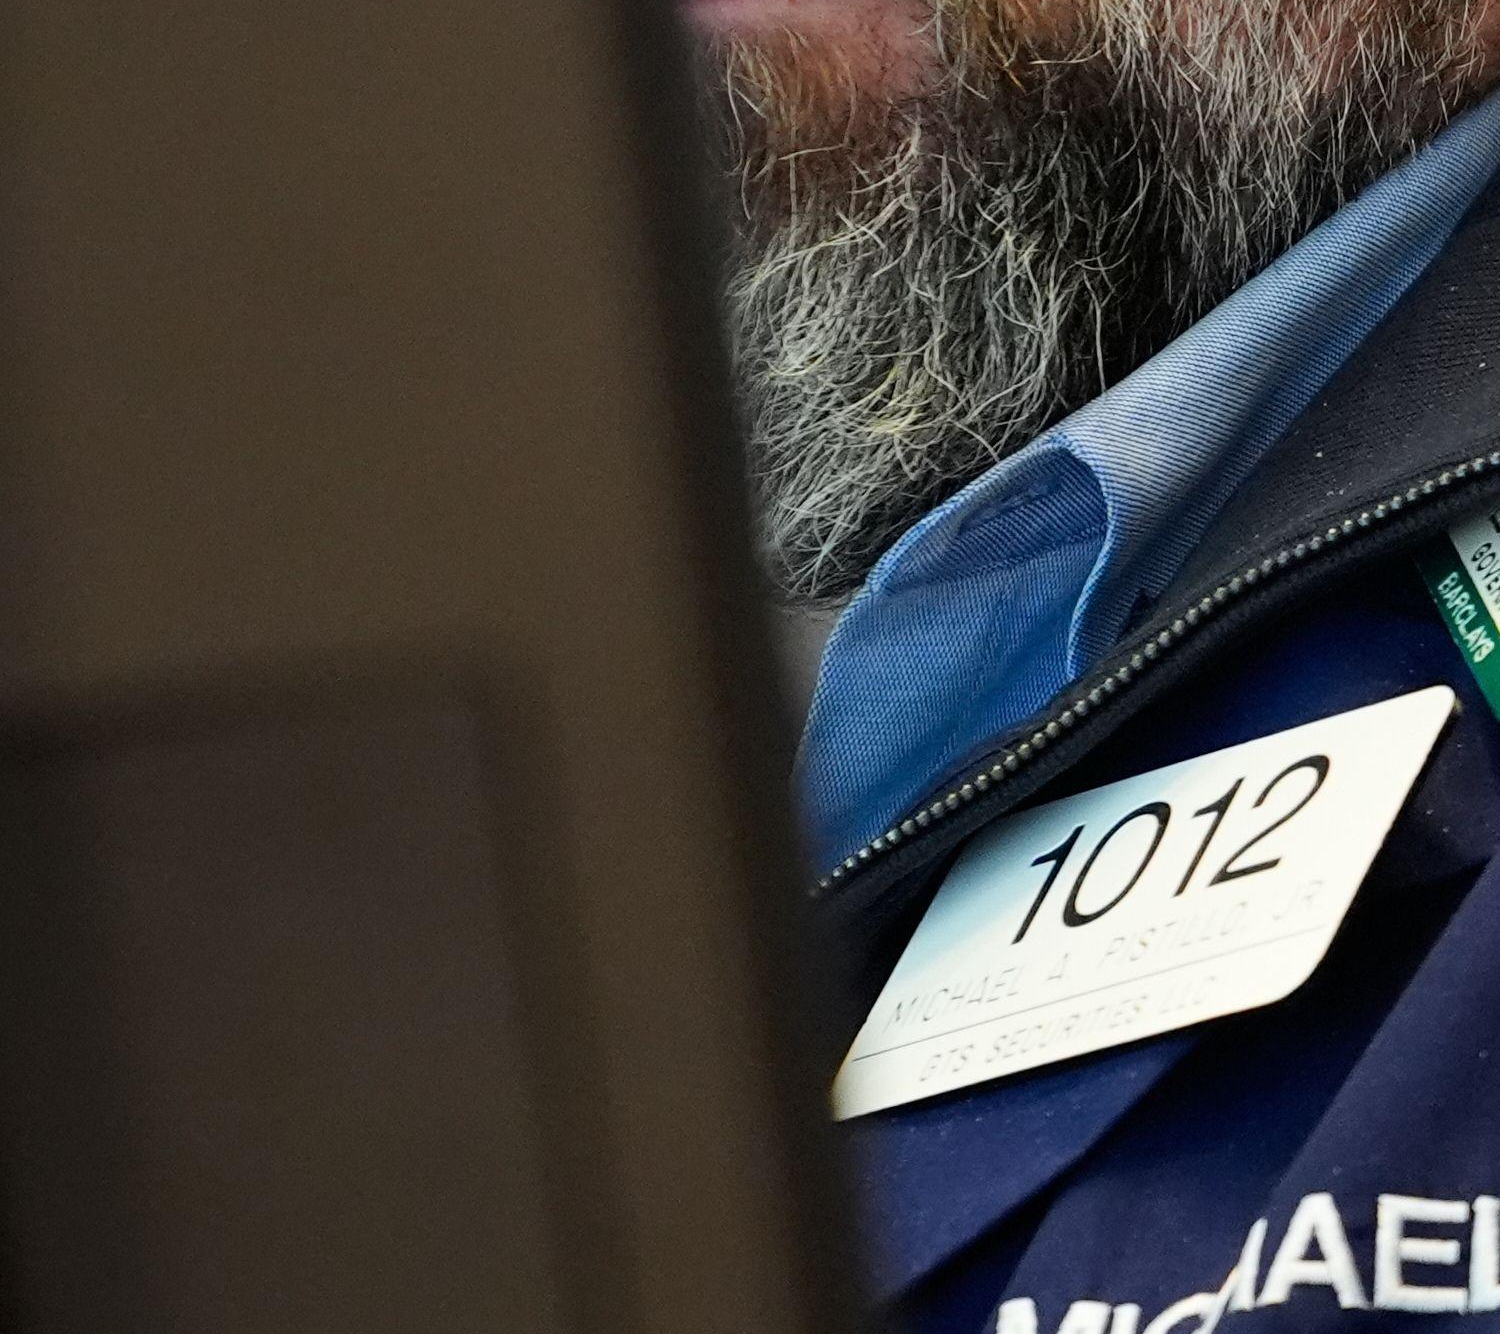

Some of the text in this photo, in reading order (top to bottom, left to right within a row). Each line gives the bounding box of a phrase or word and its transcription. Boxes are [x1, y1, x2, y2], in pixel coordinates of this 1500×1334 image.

[1437, 571, 1494, 663] BARCLAYS
[1010, 753, 1333, 947] 1012
[882, 964, 1026, 1036] MICHAEL
[917, 1042, 977, 1083] GTS
[983, 993, 1150, 1068] SECURITIES
